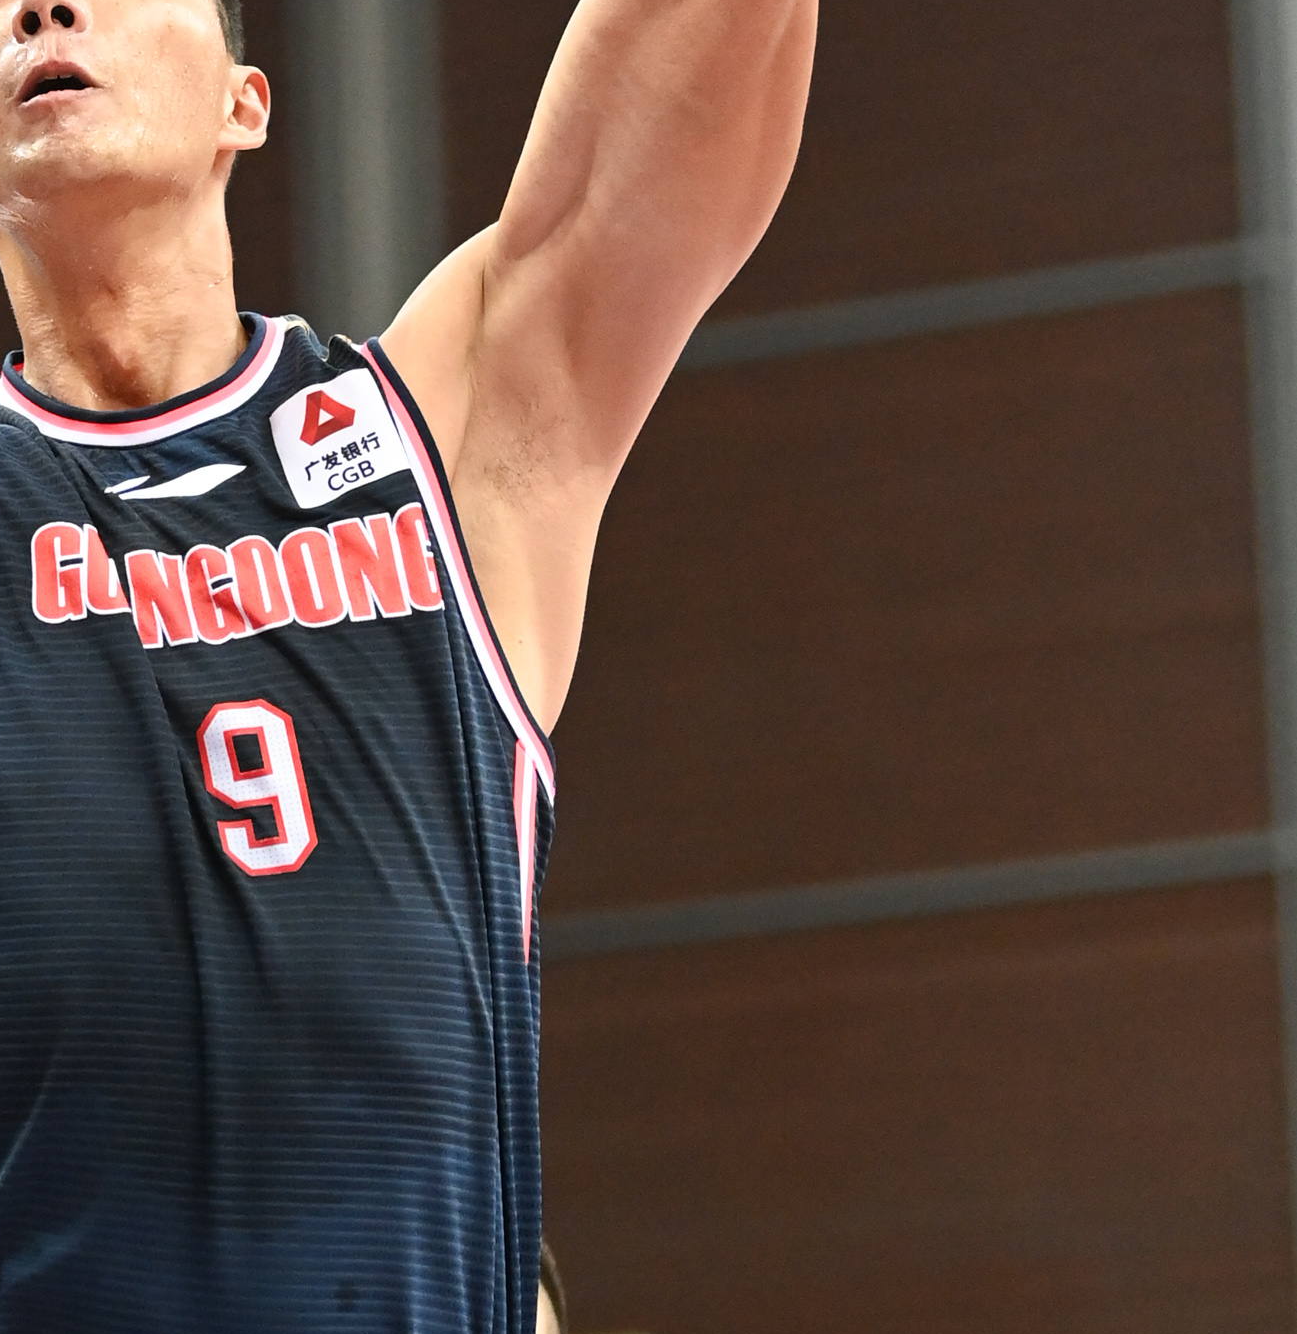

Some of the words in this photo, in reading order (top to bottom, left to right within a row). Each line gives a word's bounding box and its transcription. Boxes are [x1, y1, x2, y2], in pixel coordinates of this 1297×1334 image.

[304, 431, 381, 482] 广发银行
[327, 460, 375, 491] CGB
[31, 501, 446, 650] GUNGDONG
[196, 698, 318, 877] 9
